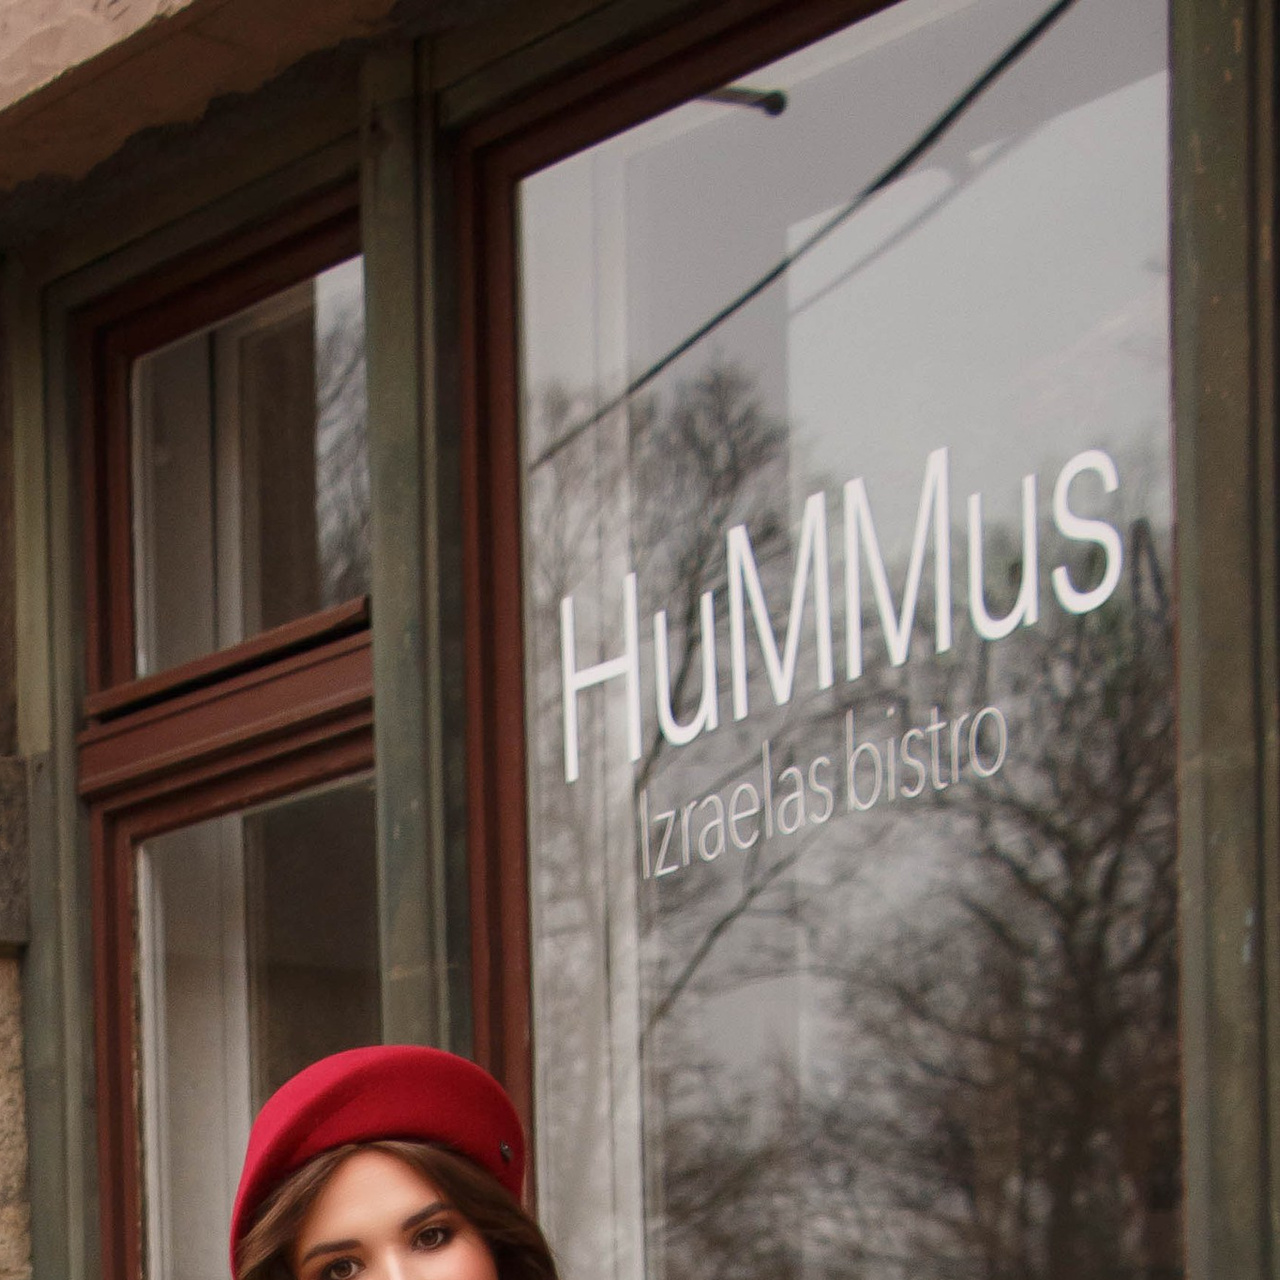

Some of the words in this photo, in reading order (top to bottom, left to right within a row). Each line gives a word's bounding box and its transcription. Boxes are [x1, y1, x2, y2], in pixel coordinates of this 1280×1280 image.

[558, 446, 1125, 783] HuMMus
[638, 739, 835, 882] Izraelas
[845, 703, 1010, 812] bistro
